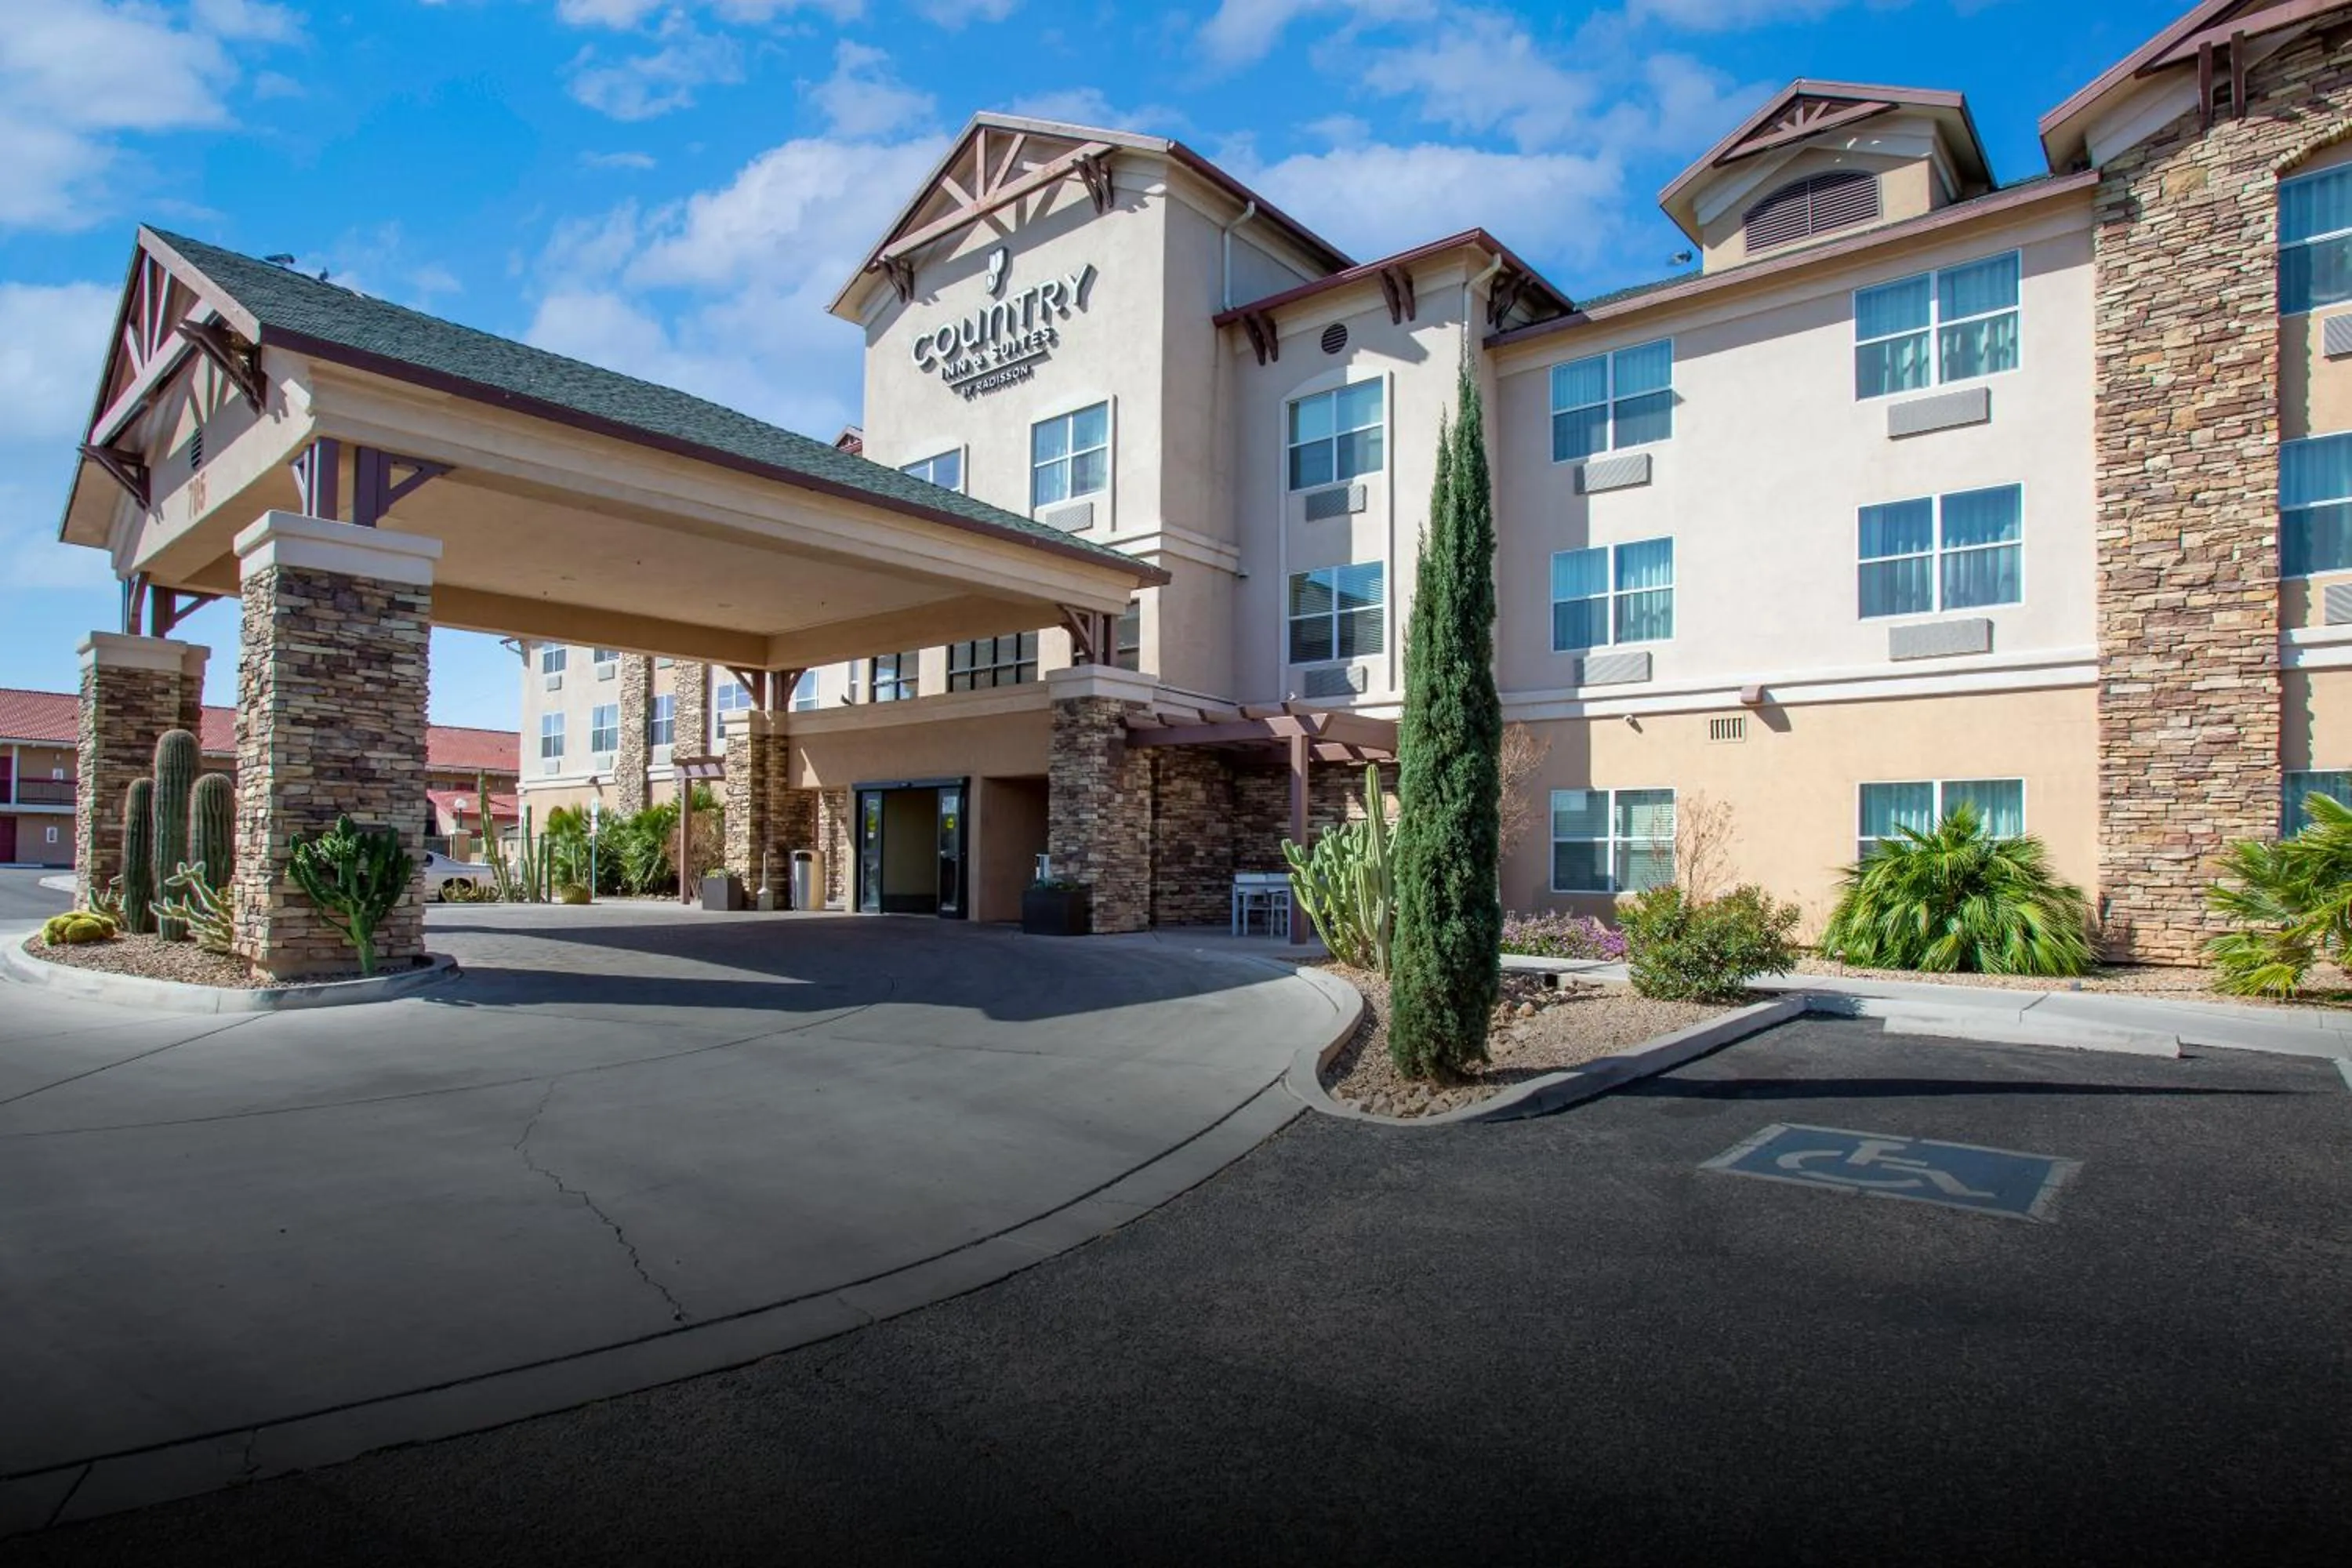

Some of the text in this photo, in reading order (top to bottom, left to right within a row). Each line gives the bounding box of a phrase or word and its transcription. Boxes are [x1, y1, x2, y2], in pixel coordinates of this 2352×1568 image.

[911, 263, 1098, 367] COUNTRY
[941, 358, 969, 379] INN
[991, 326, 1054, 360] SUITES
[975, 364, 1030, 391] RADISSON
[187, 472, 205, 520] 705
